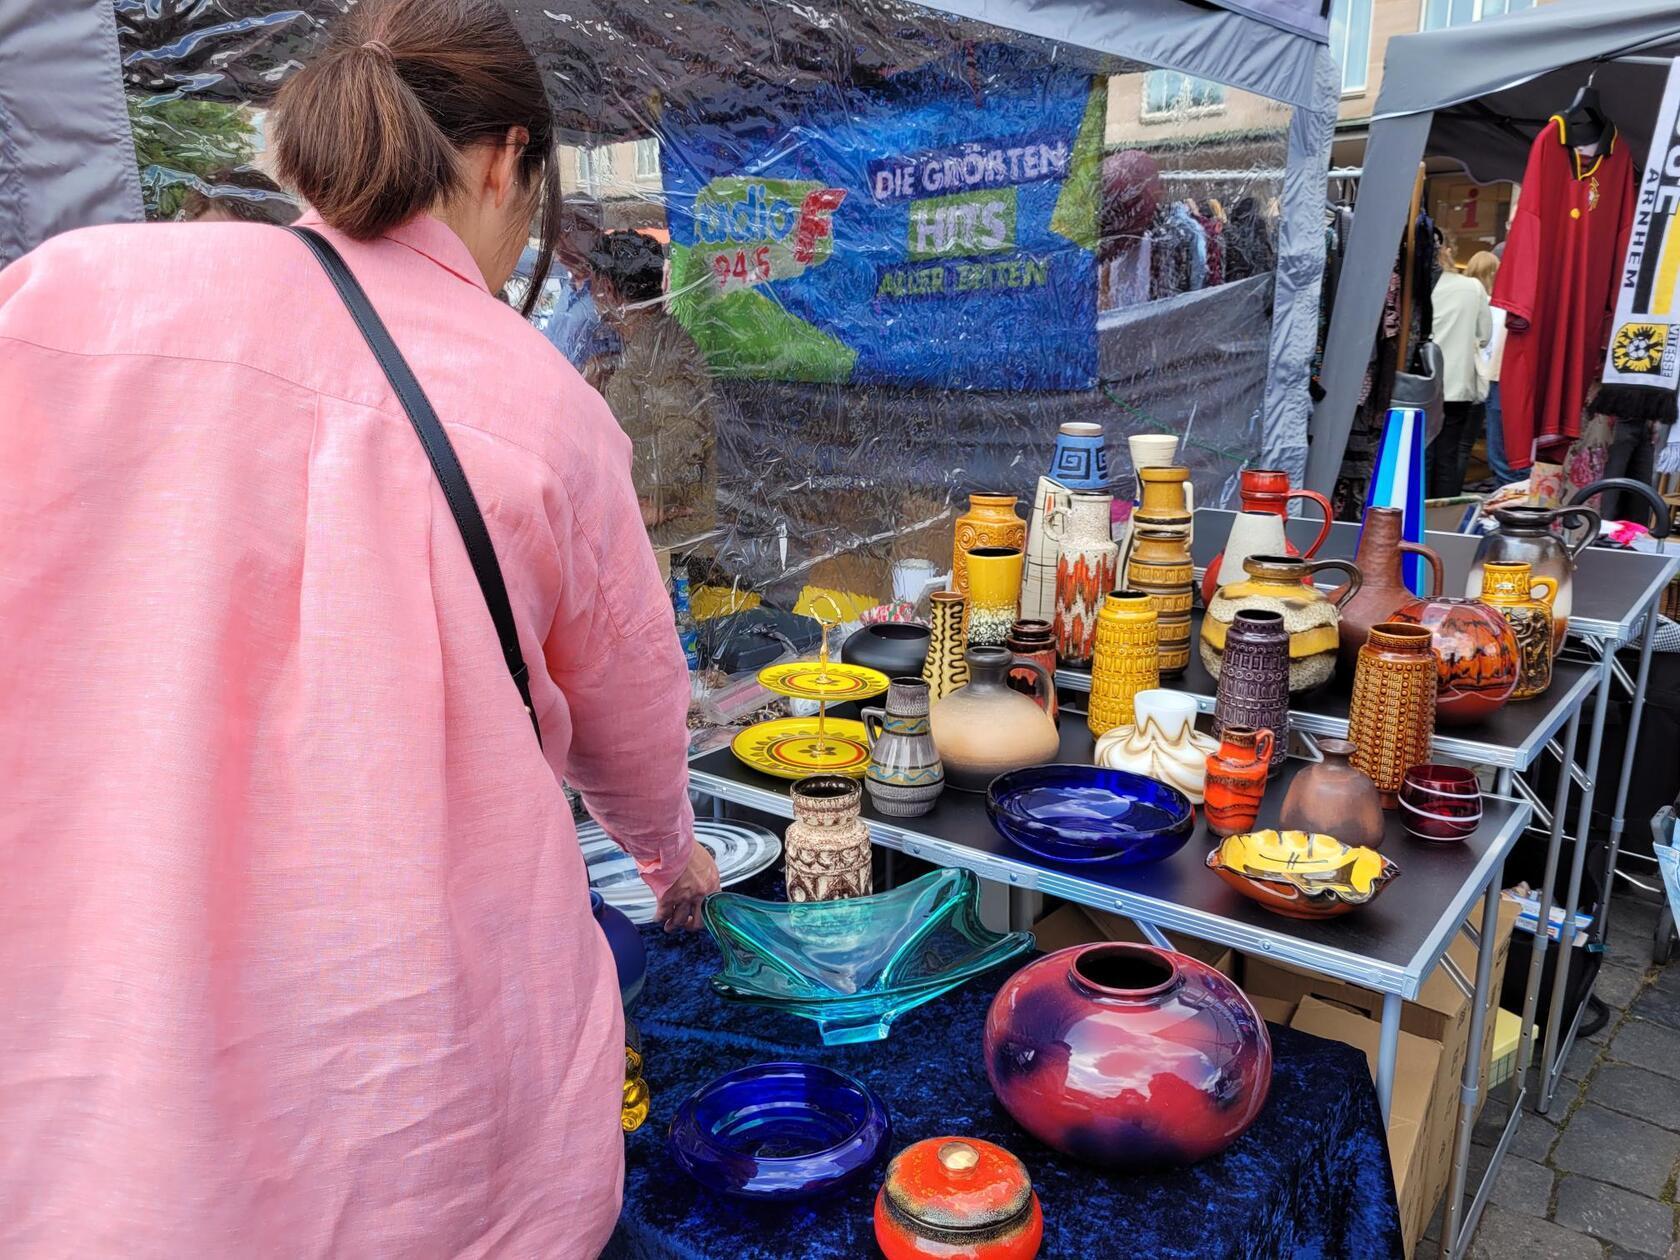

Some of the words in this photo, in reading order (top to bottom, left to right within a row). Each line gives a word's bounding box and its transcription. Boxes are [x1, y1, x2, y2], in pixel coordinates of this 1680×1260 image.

[875, 167, 915, 200] DIE
[694, 184, 796, 244] adio
[795, 188, 848, 264] F
[916, 201, 1006, 252] HITS
[1623, 168, 1659, 288] ARNHEM
[877, 267, 945, 297] ALLER
[1662, 324, 1680, 378] VITESSE
